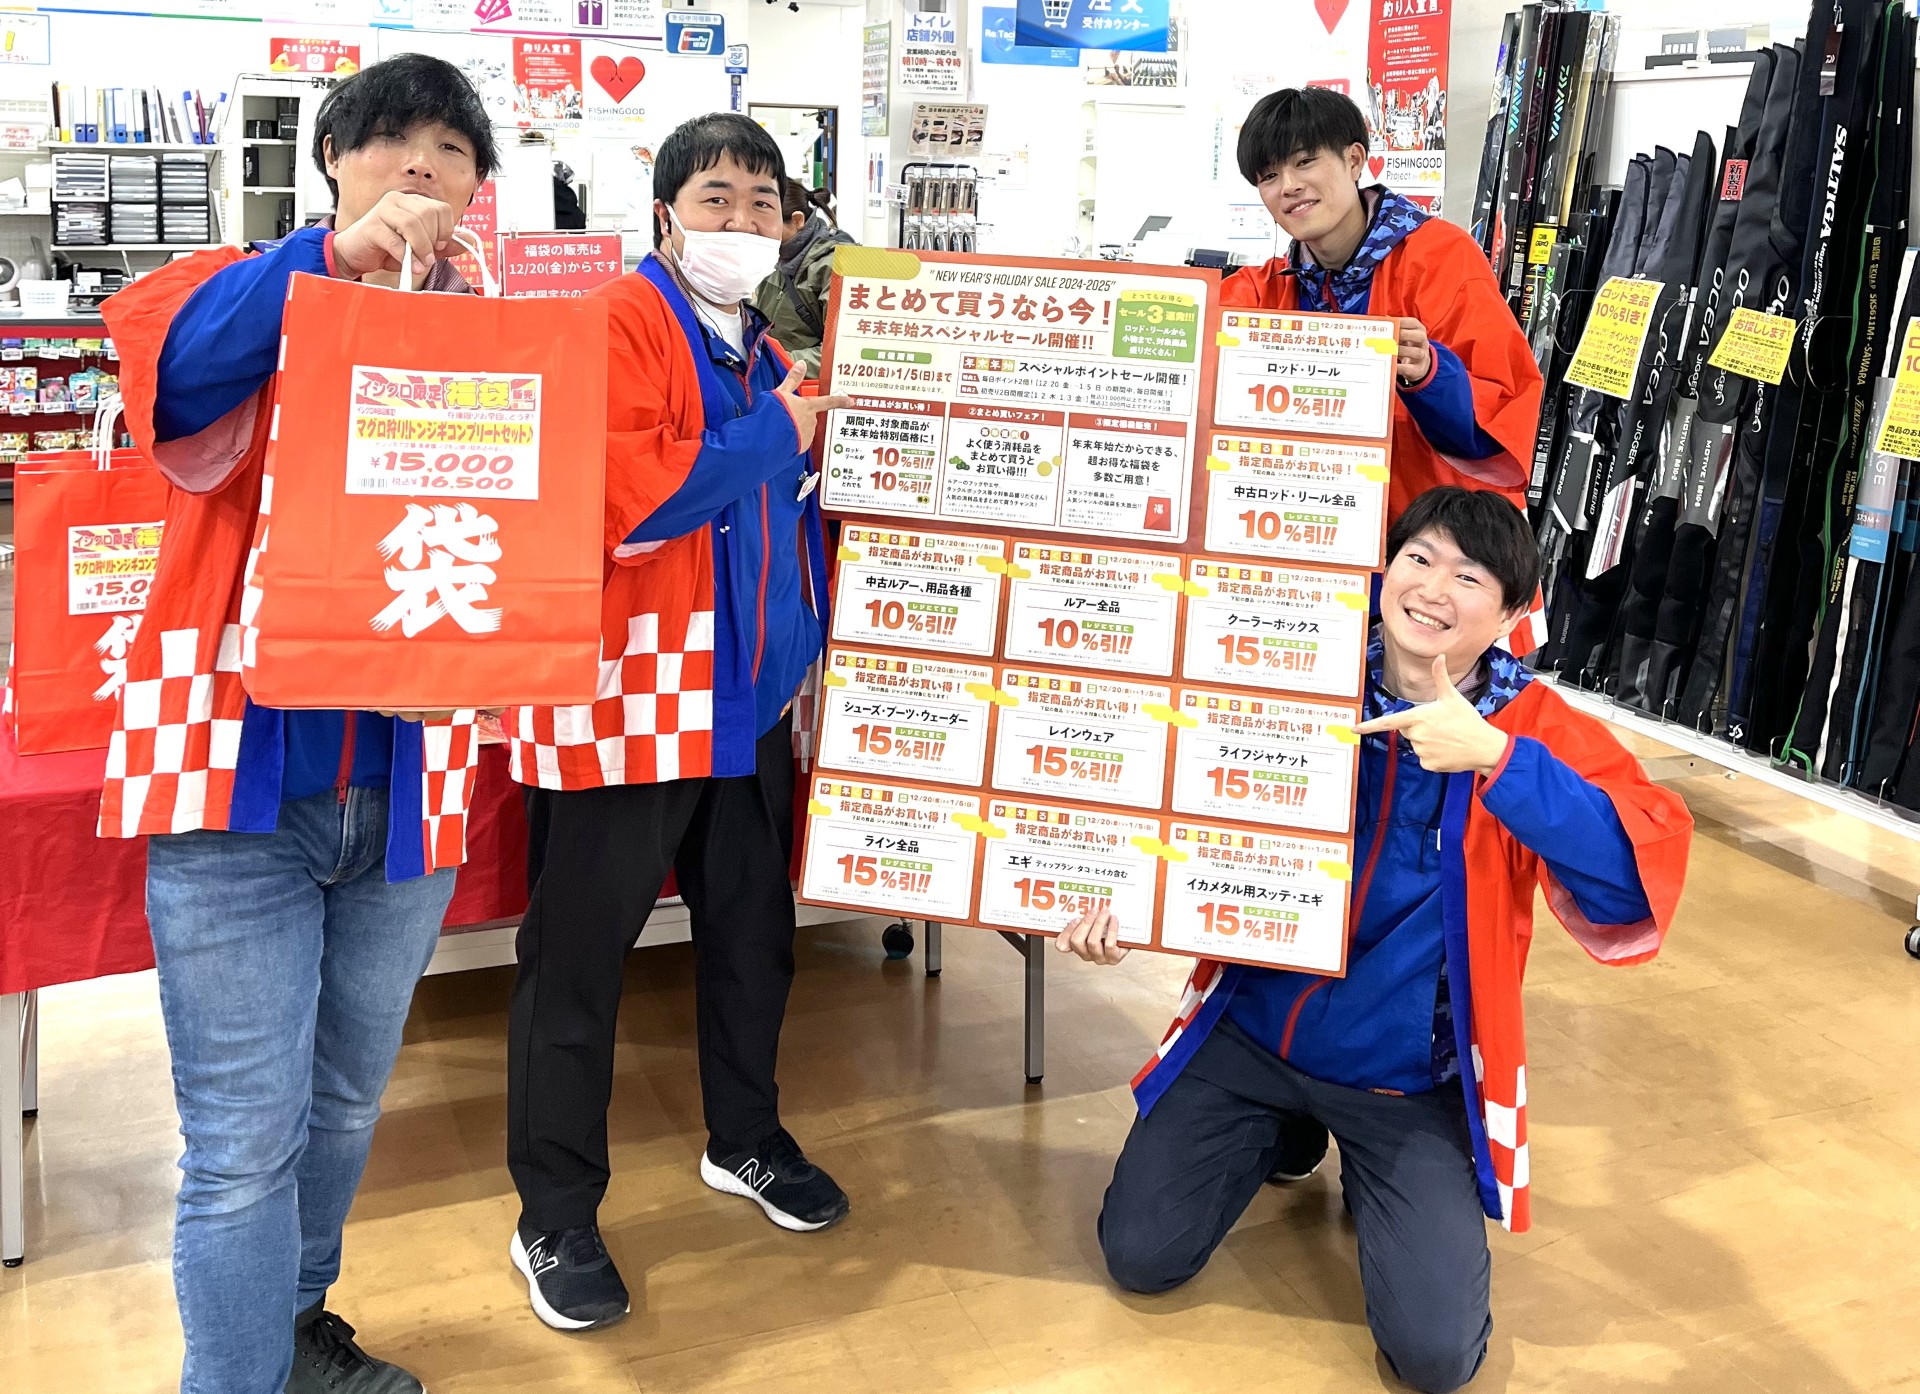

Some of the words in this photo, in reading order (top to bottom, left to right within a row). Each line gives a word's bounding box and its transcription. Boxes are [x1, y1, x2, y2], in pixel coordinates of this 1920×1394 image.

[912, 15, 951, 27] トイレ
[1082, 17, 1150, 31] 受付カウンター
[906, 29, 955, 44] 店舗外側
[522, 43, 572, 54] 釣り人宣言
[906, 48, 957, 56] 営業時間のお知らせ
[588, 107, 646, 115] FISHINGOOD
[1386, 157, 1443, 169] FISHINGOOD
[1386, 170, 1411, 181] Project
[1725, 164, 1743, 196] 新製品
[1819, 123, 1848, 240] SALTIGA
[524, 243, 602, 258] 福袋の販売は
[508, 260, 618, 276] 12/20(金)からです
[959, 271, 991, 285] YEAR'S
[993, 273, 1033, 288] HOLIDAY
[1035, 276, 1057, 289] SALE
[849, 284, 1112, 326] まとめて買うなら今!
[1132, 292, 1183, 303] とってもお得な
[1699, 266, 1725, 346] OCEA
[1595, 302, 1647, 327] 10%引き!
[856, 319, 1095, 350] 年末年始スペシャルセール開催!!
[1122, 334, 1188, 348] 小物まで、対象商品
[1248, 331, 1361, 349] 指定商品がお買い得!
[1734, 319, 1791, 342] お探しします!
[1128, 346, 1176, 357] 盛りだくさん!
[837, 364, 890, 379] 12/20(金)
[896, 368, 953, 383] 1/5(日)まで
[1018, 361, 1188, 386] スペシャルポイントセール開催!
[1267, 361, 1341, 377] ロッド・リール
[1689, 353, 1703, 397] JIGGER
[358, 381, 442, 402] イシグロ限定
[445, 380, 510, 407] 福袋
[1248, 383, 1347, 418] 10%引!!
[846, 415, 930, 432] 期間中、対象商品が
[1852, 394, 1866, 434] JERKING
[839, 426, 934, 444] 年末年始特別価格に!
[1627, 419, 1645, 466] JIGGER
[1677, 415, 1691, 453] MOTIVE
[965, 437, 1042, 455] よく使う消耗品を
[872, 446, 935, 470] 10%引!!
[970, 450, 1035, 466] まとめて買うと
[1087, 455, 1160, 472] 超お得な福袋を
[1238, 455, 1352, 475] 指定商品がお買い得!
[1556, 442, 1573, 496] FULLBEND
[1700, 440, 1712, 478] MOTIVE
[975, 463, 1028, 478] お買い得!!!
[1093, 471, 1150, 486] 多数ご用意!
[869, 470, 932, 495] 10%引!!
[1589, 461, 1602, 516] FULLBEND
[1233, 485, 1356, 507] 中古ロッド・リール全品
[1153, 503, 1164, 515] 福
[1238, 509, 1338, 546] 10%引!!
[73, 533, 133, 548] イシグロ限定
[868, 545, 973, 567] 指定商品がお買い得!
[368, 502, 504, 639] 袋
[1039, 563, 1148, 584] 指定商品がお買い得!
[865, 575, 973, 598] 中古ルアー、用品各種
[1217, 581, 1331, 603] 指定商品がお買い得!
[1064, 596, 1121, 614] ルアー全品
[865, 599, 958, 636] 10%引!!
[1228, 613, 1320, 633] クーラーボックス
[1038, 617, 1133, 655] 10%引!!
[1217, 634, 1317, 673] 15%引!!
[855, 671, 961, 693] 指定商品がお買い得!
[844, 700, 968, 725] シューズ・ブーツ・ウェーダー
[1028, 690, 1137, 714] 指定商品がお買い得!
[1049, 725, 1115, 743] レインウェア
[1207, 712, 1322, 735] 指定商品がお買い得!
[852, 723, 945, 762] 15%引!!
[1026, 744, 1123, 784] 15%引!!
[1218, 745, 1309, 768] ライフジャケット
[1207, 766, 1307, 807] 15%引!!
[840, 800, 947, 824] 指定商品がお買い得!
[864, 835, 920, 853] ライン全品
[1015, 823, 1127, 847] 指定商品がお買い得!
[1007, 855, 1033, 869] エギ
[1197, 845, 1313, 872] 指定商品がお買い得!
[837, 853, 932, 894] 15%引!!
[1186, 878, 1324, 907] イカメタル用スッテ・エギ
[1197, 902, 1299, 944] 15%引!!
[735, 1157, 775, 1193] N
